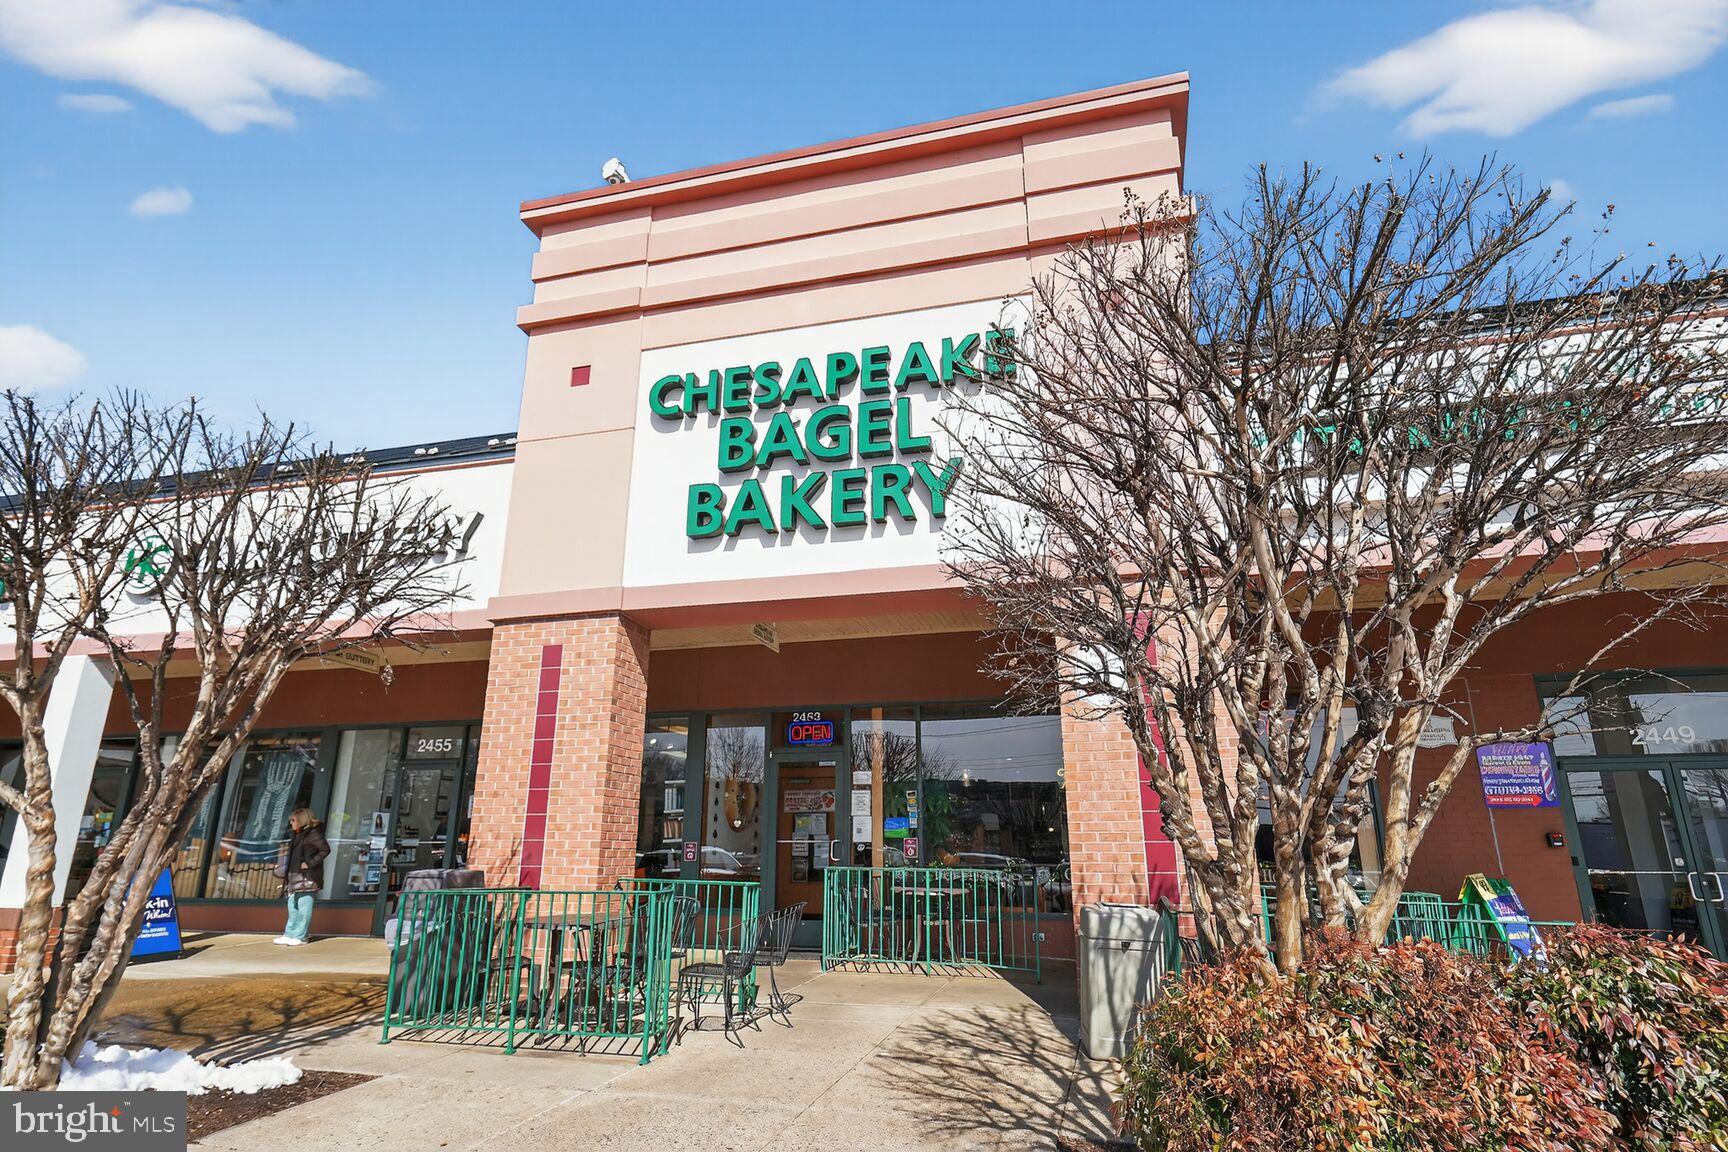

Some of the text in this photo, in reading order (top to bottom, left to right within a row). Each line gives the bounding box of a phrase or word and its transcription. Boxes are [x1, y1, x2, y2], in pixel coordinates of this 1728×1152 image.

[649, 327, 1018, 420] CHESAPEAKE
[718, 397, 932, 473] BAGEL
[686, 457, 964, 540] BAKERY
[417, 738, 452, 752] 2455
[791, 724, 831, 741] OPEN
[1630, 725, 1696, 745] 2449
